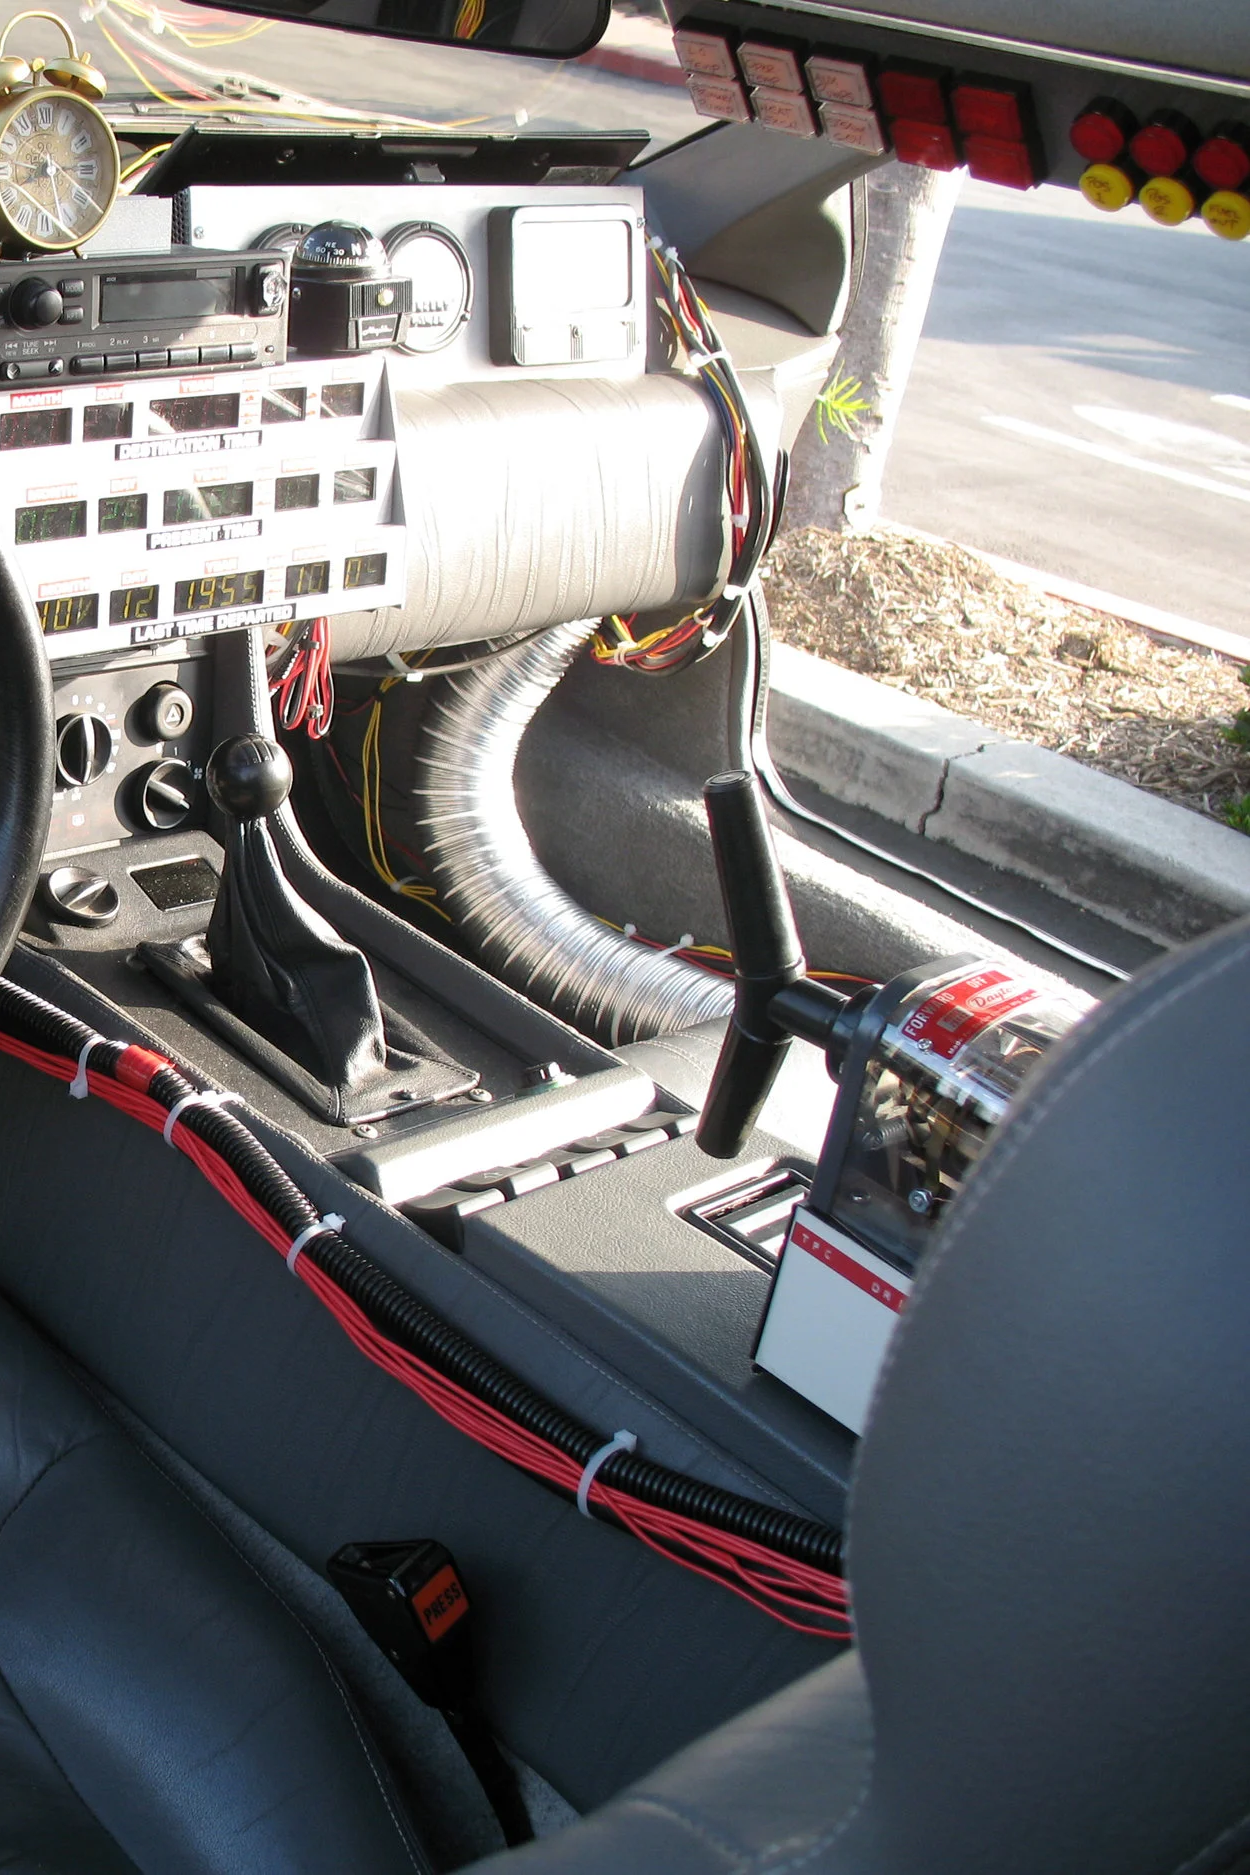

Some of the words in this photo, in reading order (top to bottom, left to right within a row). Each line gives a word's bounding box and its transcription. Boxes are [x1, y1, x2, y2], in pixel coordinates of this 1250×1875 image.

[304, 237, 315, 249] E
[333, 248, 345, 256] 30
[351, 243, 362, 255] N
[120, 434, 221, 460] DESTINATION
[151, 525, 220, 549] PRESENT
[222, 520, 261, 540] TIME
[123, 586, 155, 619] 12
[188, 572, 258, 609] 1955
[135, 623, 175, 643] LAST
[177, 616, 215, 637] TIME
[216, 604, 293, 631] DEPARTED
[965, 976, 988, 989] OFF
[904, 992, 955, 1037] FORWARD
[423, 1582, 462, 1626] PRESS
